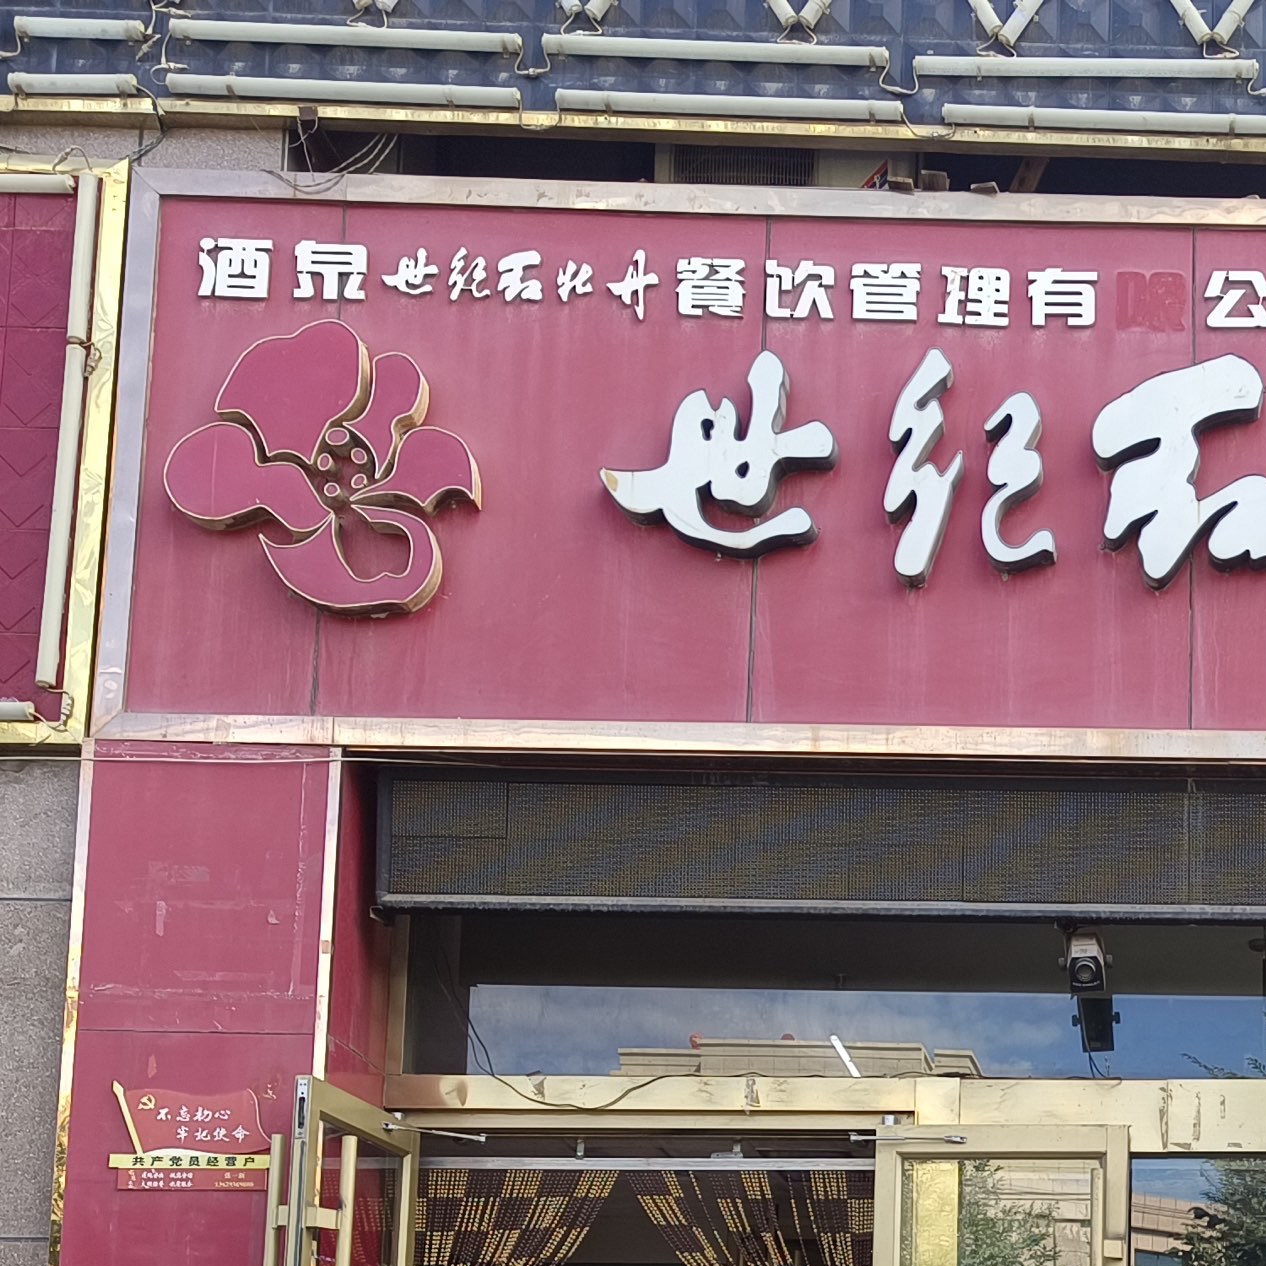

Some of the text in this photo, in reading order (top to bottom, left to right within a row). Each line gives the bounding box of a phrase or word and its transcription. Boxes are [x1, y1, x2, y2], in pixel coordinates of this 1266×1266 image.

[156, 1106, 232, 1122] 不忘初心
[176, 1125, 250, 1143] 牢记使命
[131, 1155, 256, 1168] 共产党员经营户
